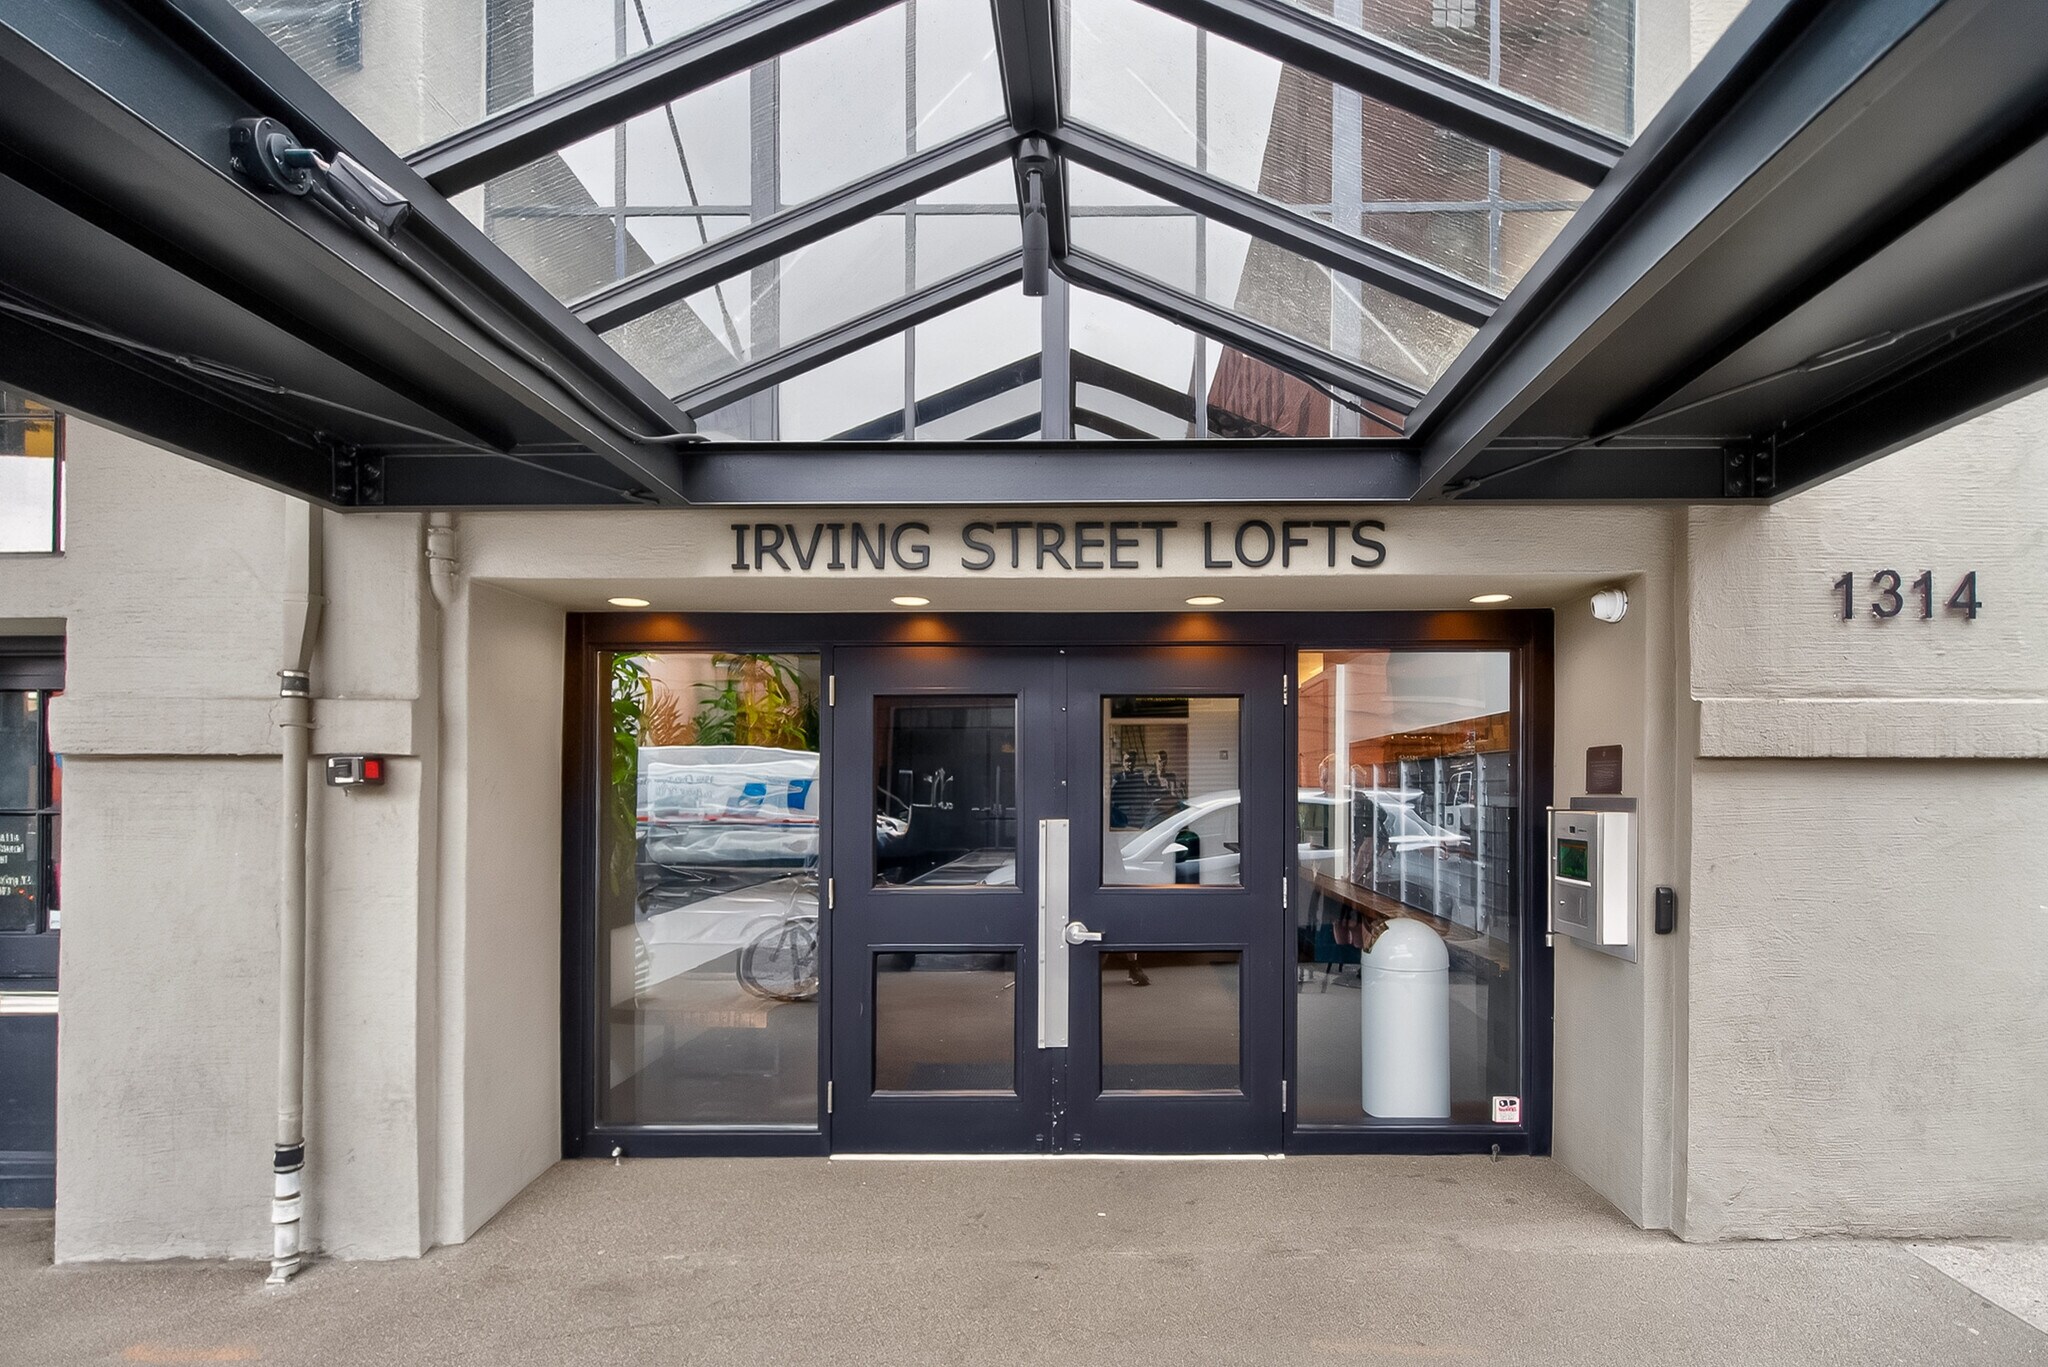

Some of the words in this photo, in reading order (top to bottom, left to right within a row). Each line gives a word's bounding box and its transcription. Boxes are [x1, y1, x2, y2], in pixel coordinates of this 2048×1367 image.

[730, 521, 931, 571] IRVING
[960, 520, 1178, 571] STREET
[1203, 519, 1388, 569] LOFTS
[1834, 569, 1983, 620] 1314
